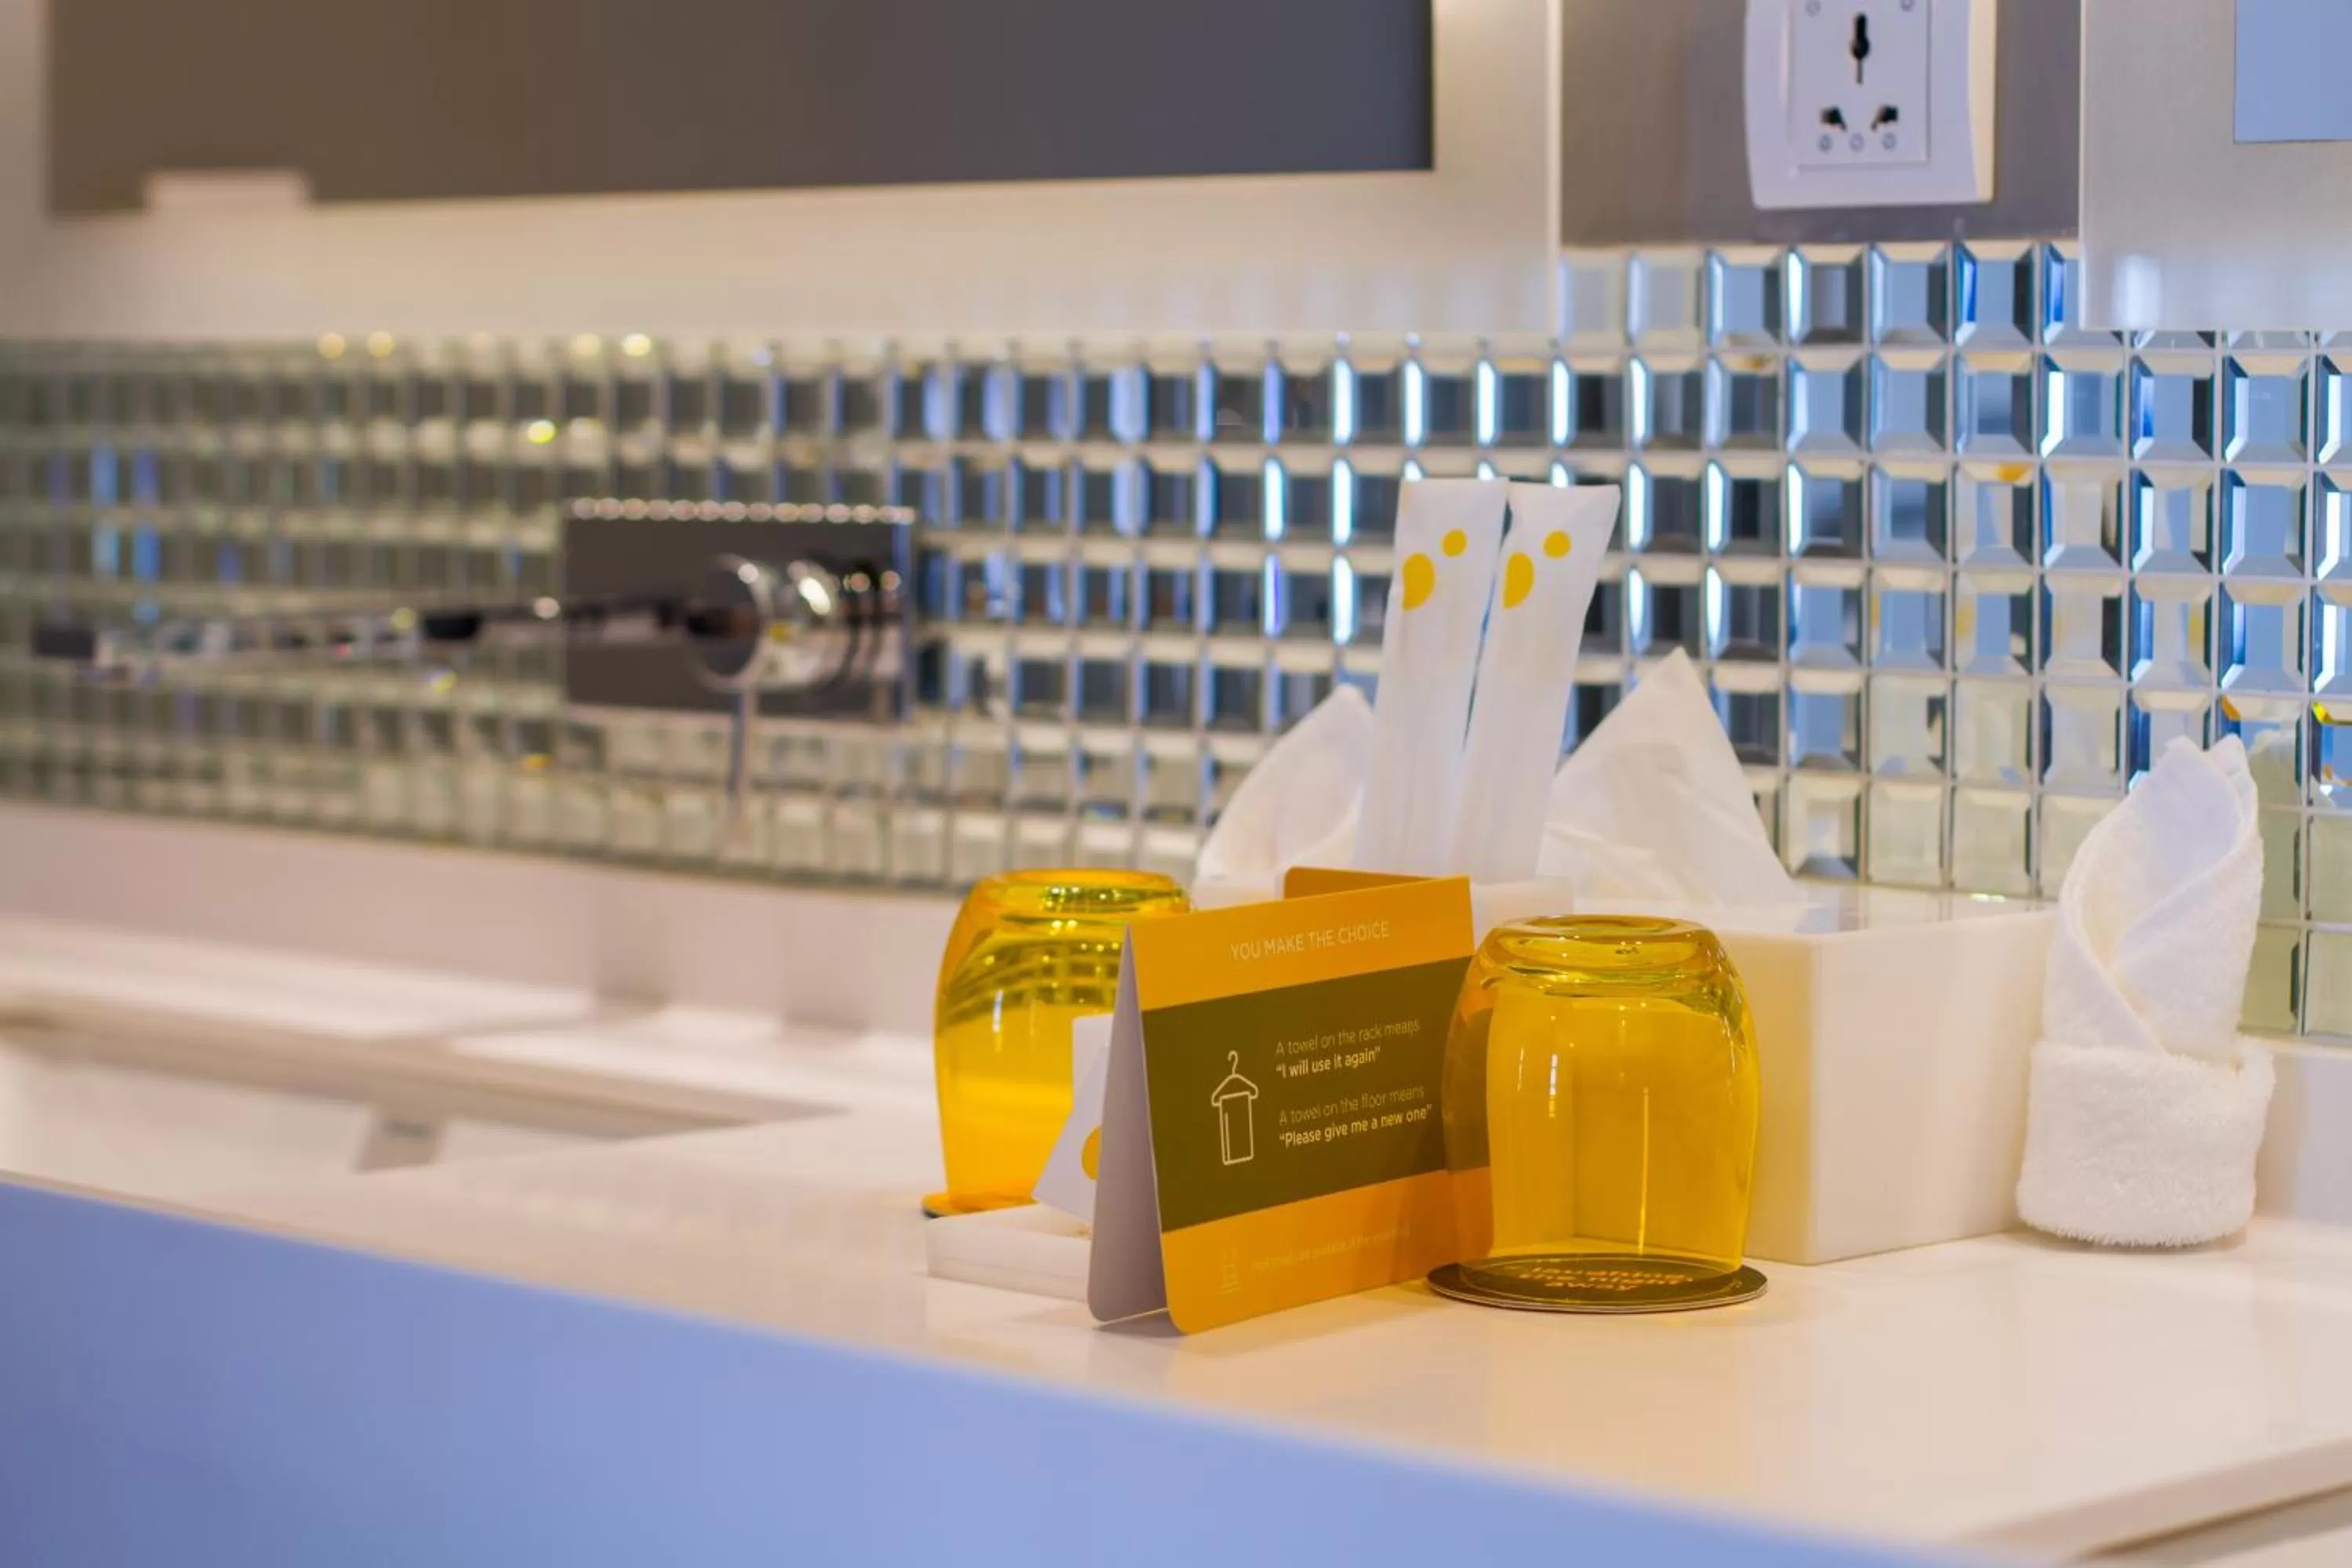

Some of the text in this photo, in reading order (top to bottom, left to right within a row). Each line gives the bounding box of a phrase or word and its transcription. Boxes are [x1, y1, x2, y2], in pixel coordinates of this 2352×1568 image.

[1230, 921, 1389, 960] YOU MAKE THE CHOICE
[1276, 1019, 1420, 1055] A towel on the rack means
[1289, 1058, 1308, 1077] will
[1312, 1058, 1330, 1073] use
[1334, 1053, 1342, 1069] it
[1279, 1085, 1425, 1126] A towel on the floor means
[1324, 1122, 1348, 1142] give
[1351, 1119, 1367, 1134] me
[1371, 1117, 1377, 1130] a
[1381, 1112, 1403, 1127] new
